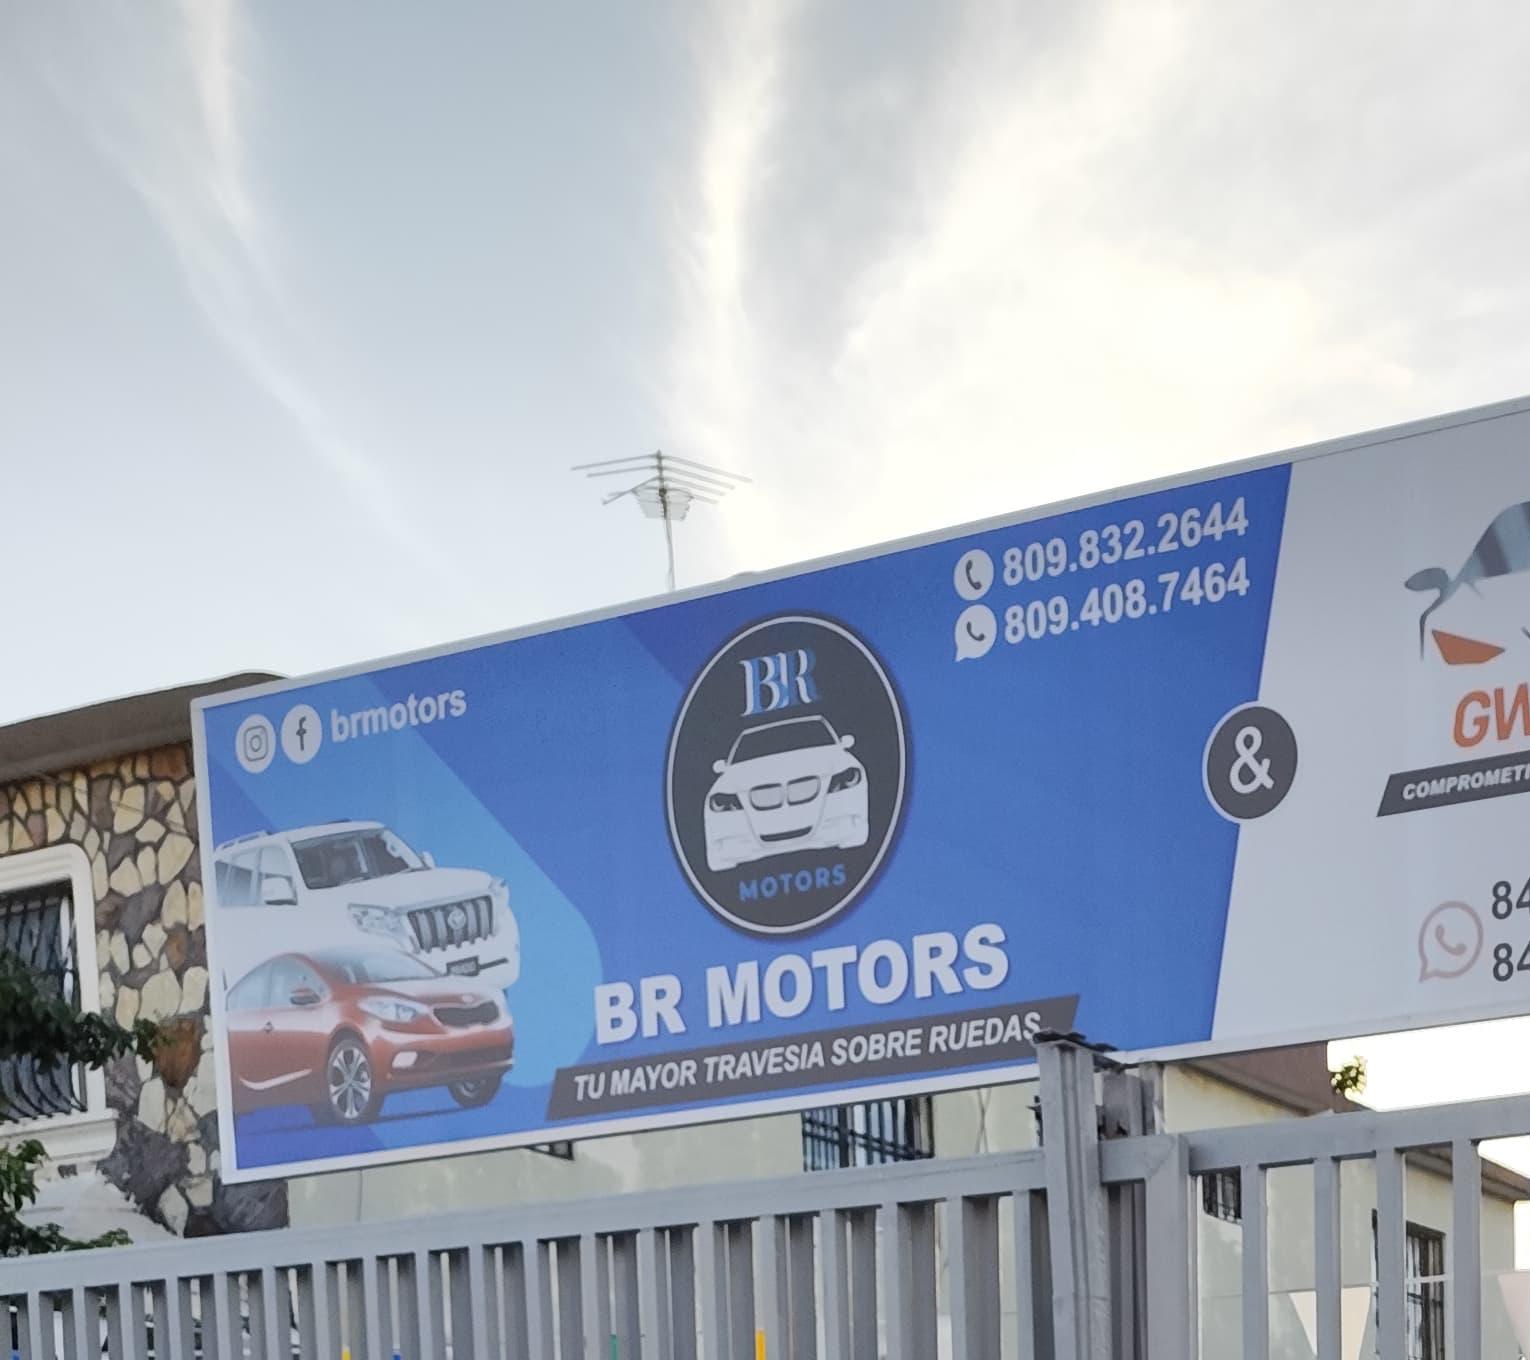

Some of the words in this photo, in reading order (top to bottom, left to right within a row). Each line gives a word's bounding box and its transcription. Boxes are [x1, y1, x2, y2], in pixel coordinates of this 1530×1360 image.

[1003, 497, 1247, 586] 809.832.2644
[1005, 557, 1249, 644] 809.408.7464
[331, 688, 467, 743] brmotors
[739, 648, 817, 717] BR
[1230, 726, 1273, 794] &
[739, 865, 847, 903] MOTORS
[595, 975, 686, 1044] BR
[706, 924, 1009, 1028] MOTORS
[574, 1074, 606, 1102] TU
[610, 1058, 697, 1097] MAYOR
[703, 1042, 825, 1084] TRAVESIA
[831, 1029, 921, 1068] SOBRE
[929, 1011, 1042, 1055] RUEDAS
